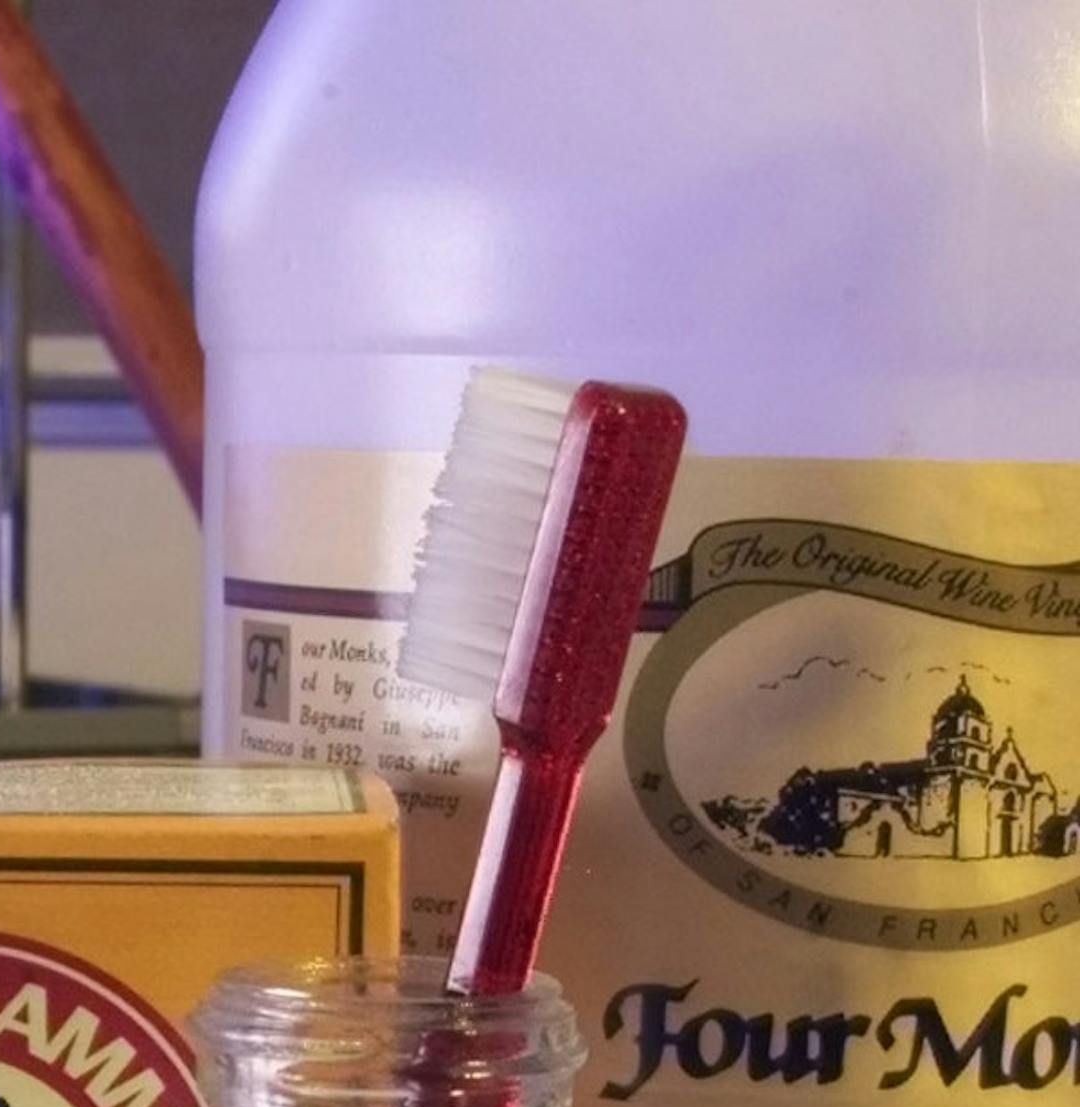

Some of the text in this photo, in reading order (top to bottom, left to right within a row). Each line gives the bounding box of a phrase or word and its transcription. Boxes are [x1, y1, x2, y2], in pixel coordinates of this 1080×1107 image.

[709, 533, 783, 578] The
[793, 533, 932, 585] Original
[938, 568, 1018, 612] Wine
[334, 673, 354, 704] by
[378, 754, 415, 773] was
[428, 752, 461, 776] the
[669, 813, 708, 858] OF
[736, 870, 830, 924] SAN
[600, 979, 871, 1100] Four
